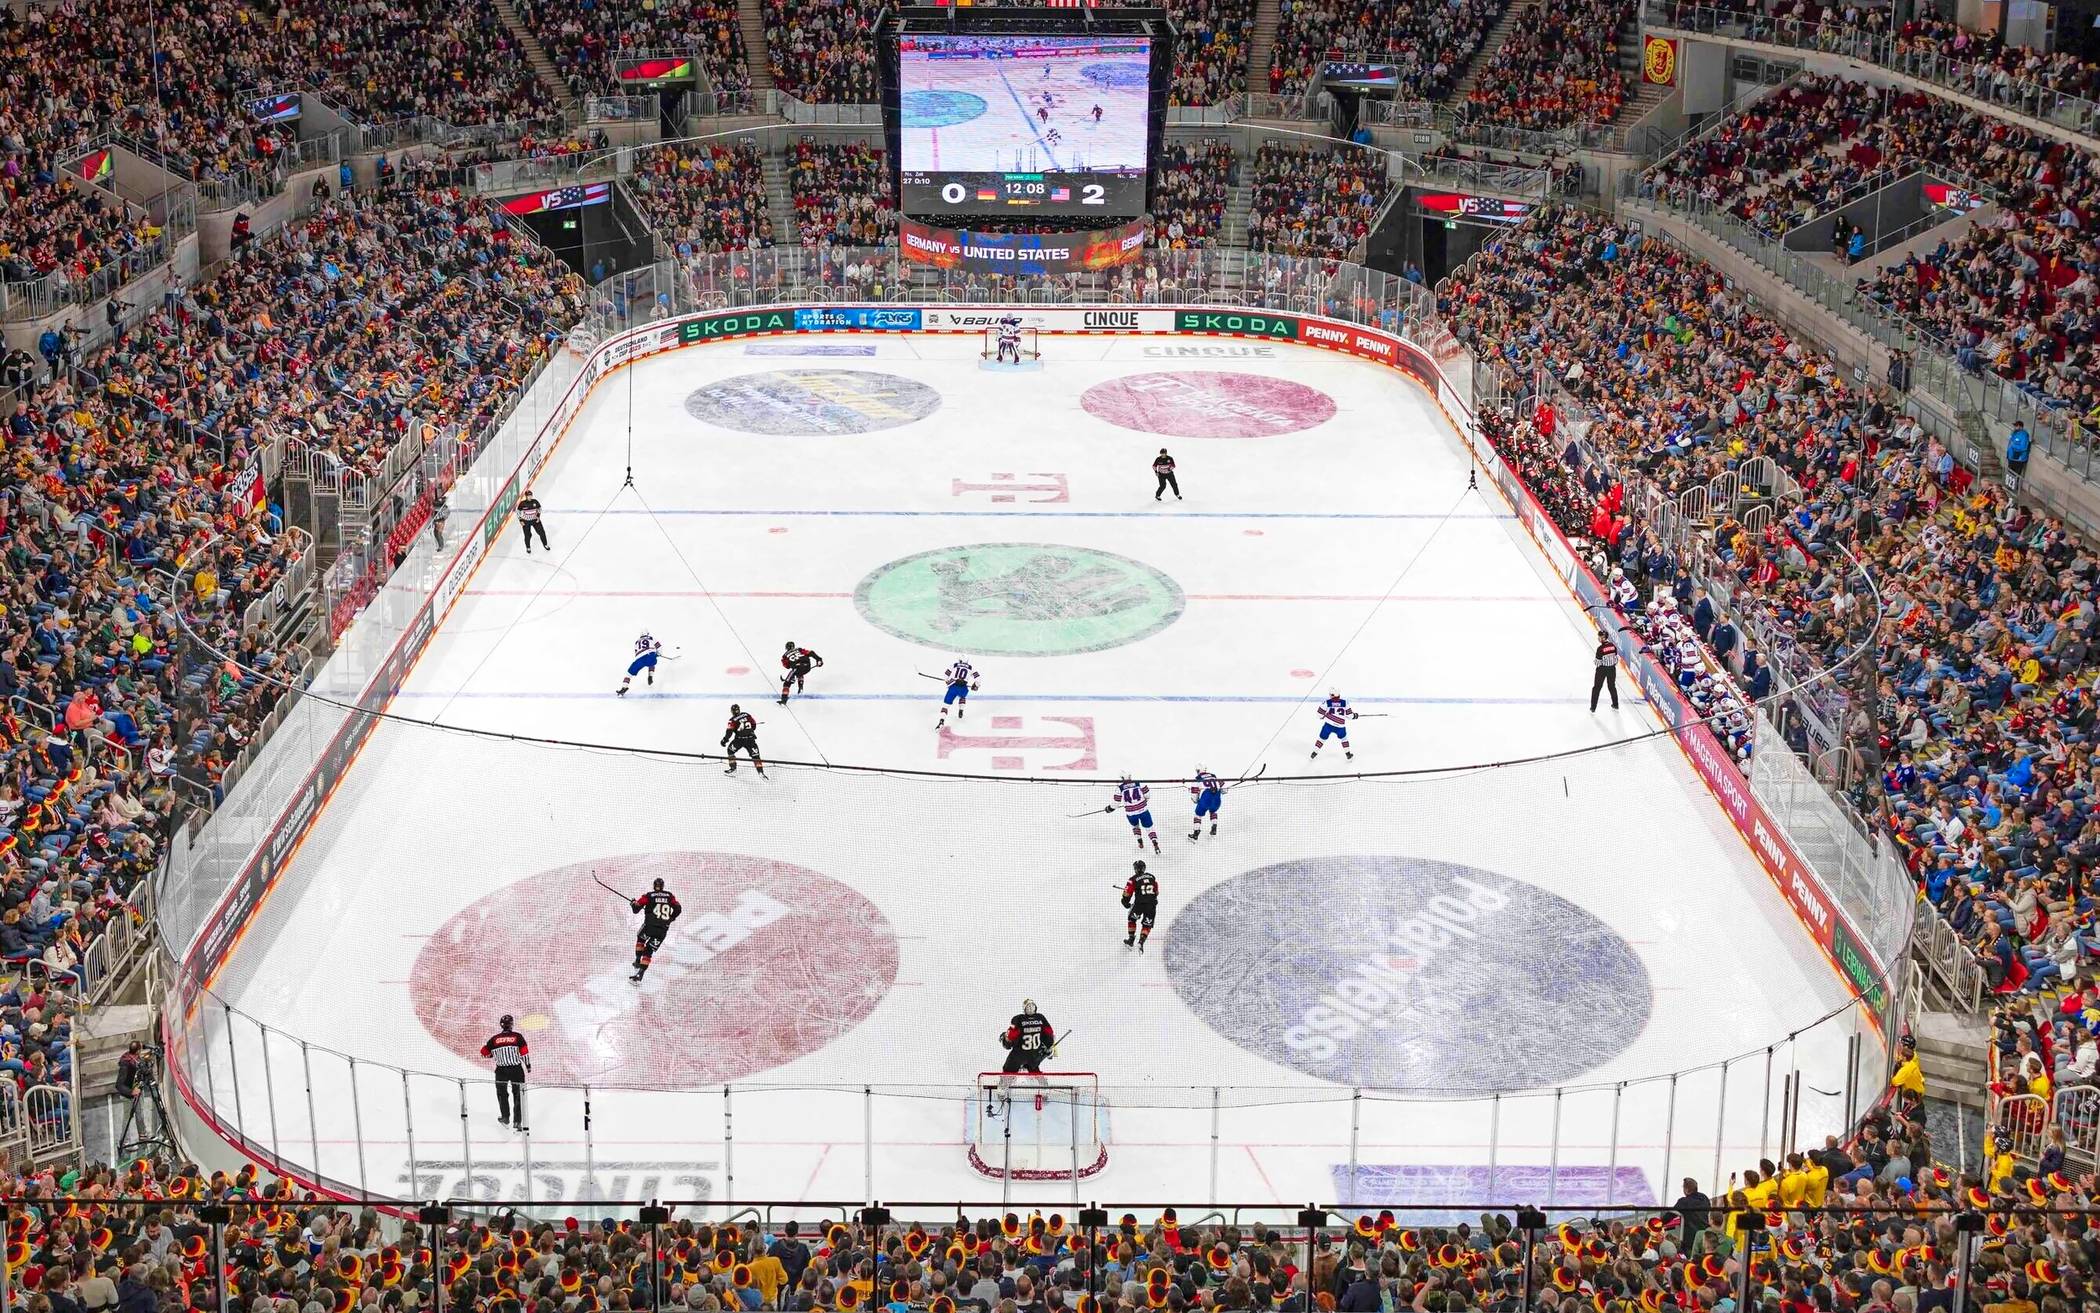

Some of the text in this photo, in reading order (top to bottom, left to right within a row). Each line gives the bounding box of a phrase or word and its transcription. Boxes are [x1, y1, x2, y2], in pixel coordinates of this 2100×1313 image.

[942, 184, 966, 203] 0
[1006, 183, 1045, 194] 12:08
[1082, 185, 1105, 204] 2
[540, 191, 562, 209] VS
[1458, 199, 1478, 213] VS
[907, 234, 946, 254] GERMANY
[964, 247, 1014, 260] UNITED
[1018, 248, 1069, 260] STATES
[1084, 312, 1138, 326] CINQUE
[954, 667, 968, 680] 10
[1721, 774, 1748, 820] SPORT
[653, 903, 671, 920] 49
[1021, 1034, 1041, 1050] 30
